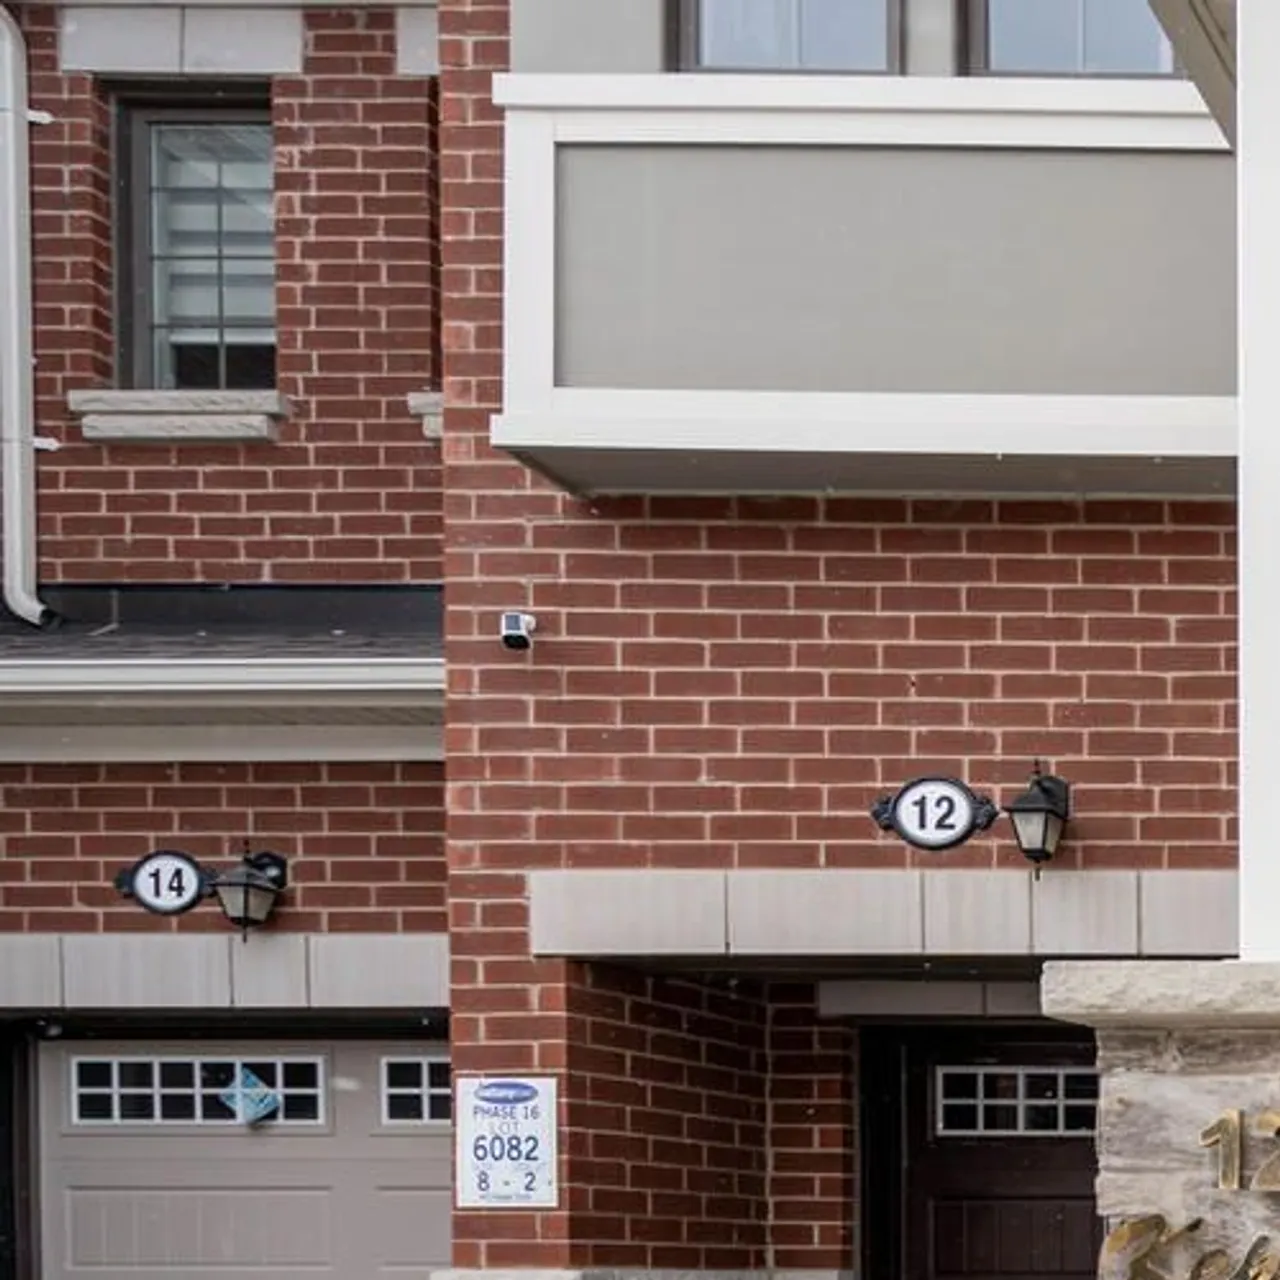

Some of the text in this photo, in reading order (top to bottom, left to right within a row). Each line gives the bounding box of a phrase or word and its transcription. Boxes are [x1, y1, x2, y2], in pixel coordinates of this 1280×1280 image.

[911, 793, 956, 831] 12
[148, 867, 186, 898] 14
[473, 1104, 541, 1120] PHASE 16
[473, 1135, 539, 1161] 6082
